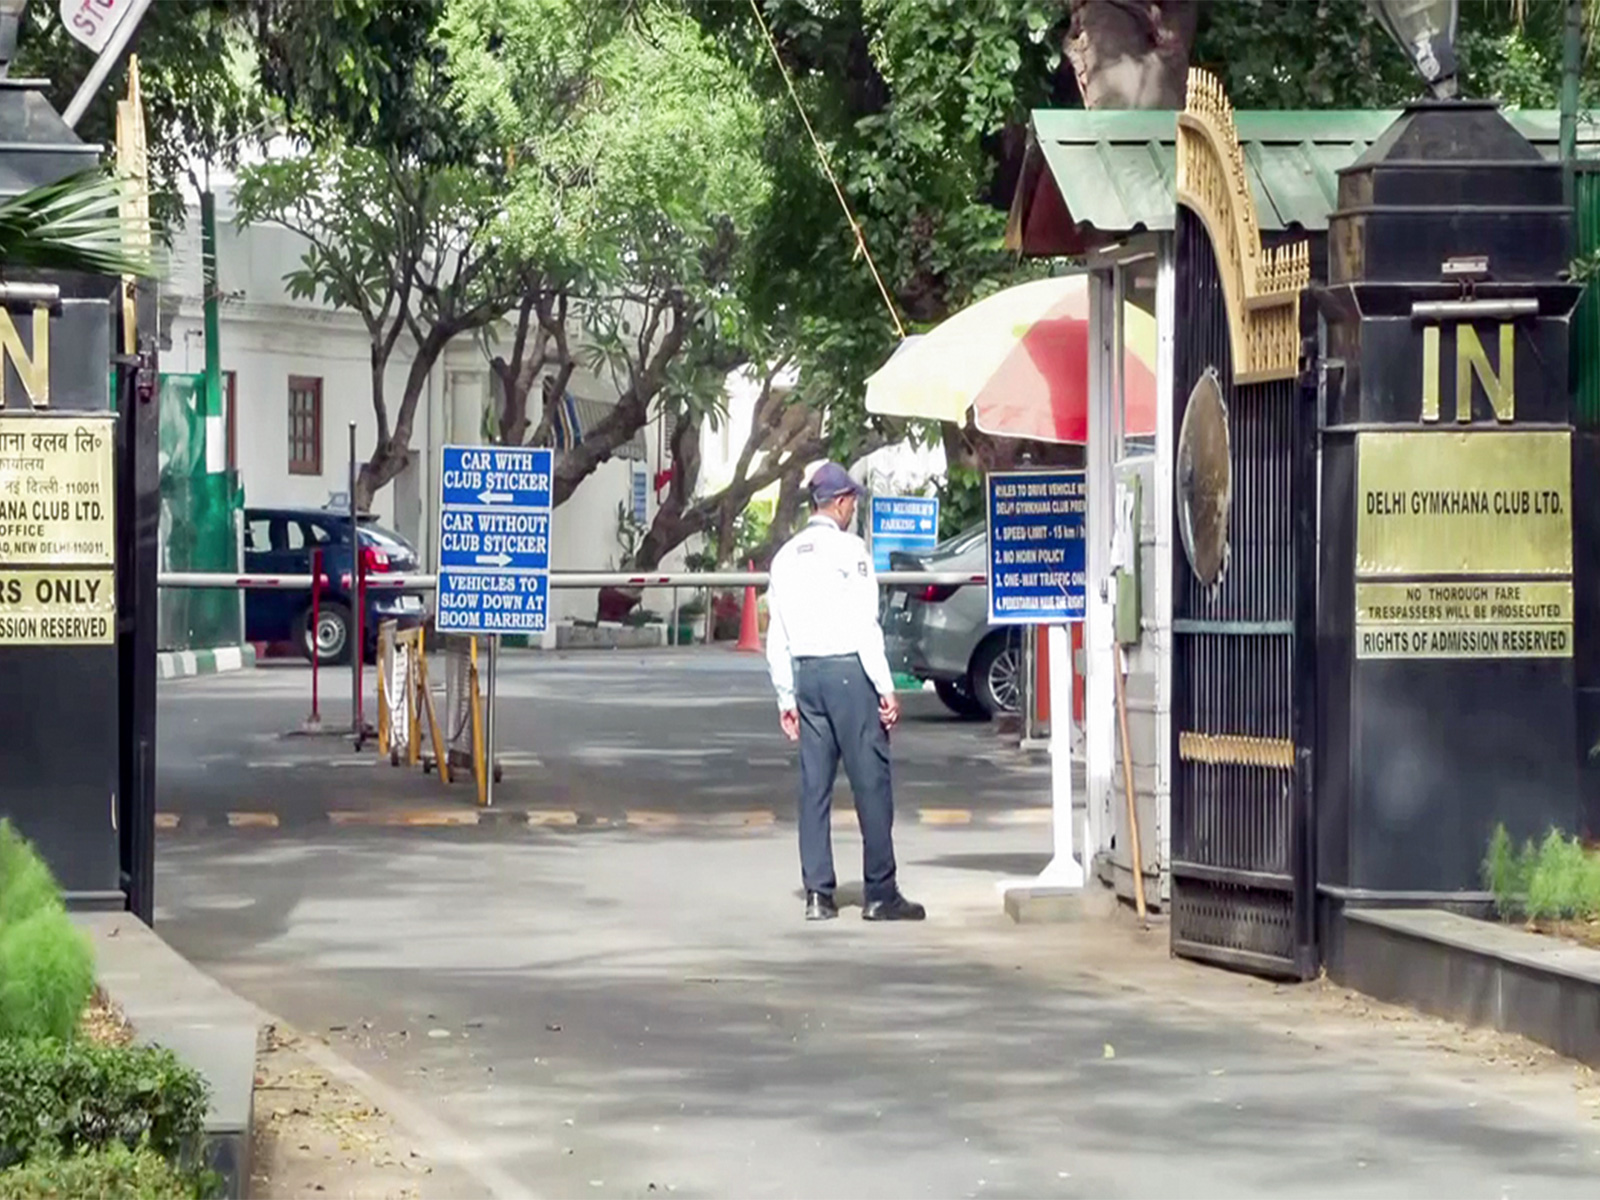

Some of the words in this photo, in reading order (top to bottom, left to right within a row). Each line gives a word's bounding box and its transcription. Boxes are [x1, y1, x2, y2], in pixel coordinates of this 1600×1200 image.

[1422, 323, 1514, 420] IN
[461, 452, 491, 470] CAR
[495, 453, 532, 471] WITH
[444, 470, 482, 489] CLUB
[486, 472, 549, 491] STICKER
[1018, 484, 1027, 496] TO
[1028, 483, 1047, 496] DRIVE
[1049, 482, 1076, 495] VEHICLE
[32, 501, 69, 520] CLUB
[75, 501, 104, 520] LTD.
[1052, 500, 1069, 513] CLUB
[1367, 491, 1406, 514] DELHI
[1411, 491, 1490, 514] GYMKHANA
[1494, 491, 1530, 514] CLUB
[1535, 491, 1563, 514] LTD.
[0, 525, 44, 536] OFFICE
[443, 513, 473, 531] CAR
[478, 514, 547, 533] WITHOUT
[1003, 526, 1026, 540] SPEED
[1028, 526, 1048, 539] LIMIT
[14, 542, 37, 553] NEW
[442, 533, 480, 551] CLUB
[484, 535, 546, 554] STICKER
[995, 550, 1002, 564] 2.
[1003, 550, 1014, 563] NO
[1016, 549, 1037, 563] HORN
[1039, 548, 1065, 563] POLICY
[448, 575, 515, 591] VEHICLES
[519, 577, 538, 592] TO
[996, 573, 1002, 587] 3.
[1004, 573, 1038, 587] ONE-WAY
[1040, 572, 1070, 586] TRAFFIC
[36, 579, 101, 604] ONLY
[1406, 588, 1422, 601] NO
[1429, 588, 1488, 601] THOROUGH
[1495, 587, 1520, 600] FARE
[441, 593, 479, 608] SLOW
[483, 594, 523, 610] DOWN
[526, 595, 544, 610] AT
[440, 611, 480, 626] BOOM
[484, 612, 544, 628] BARRIER
[1369, 605, 1442, 619] TRESPASSERS
[1445, 605, 1470, 619] WILL
[1474, 605, 1487, 618] BE
[1491, 604, 1560, 618] PROSECUTED
[41, 617, 107, 638] RESERVED
[1364, 632, 1408, 652] RIGHTS
[1412, 632, 1428, 651] OF
[1431, 631, 1498, 651] ADMISSION
[1502, 630, 1566, 650] RESERVED
